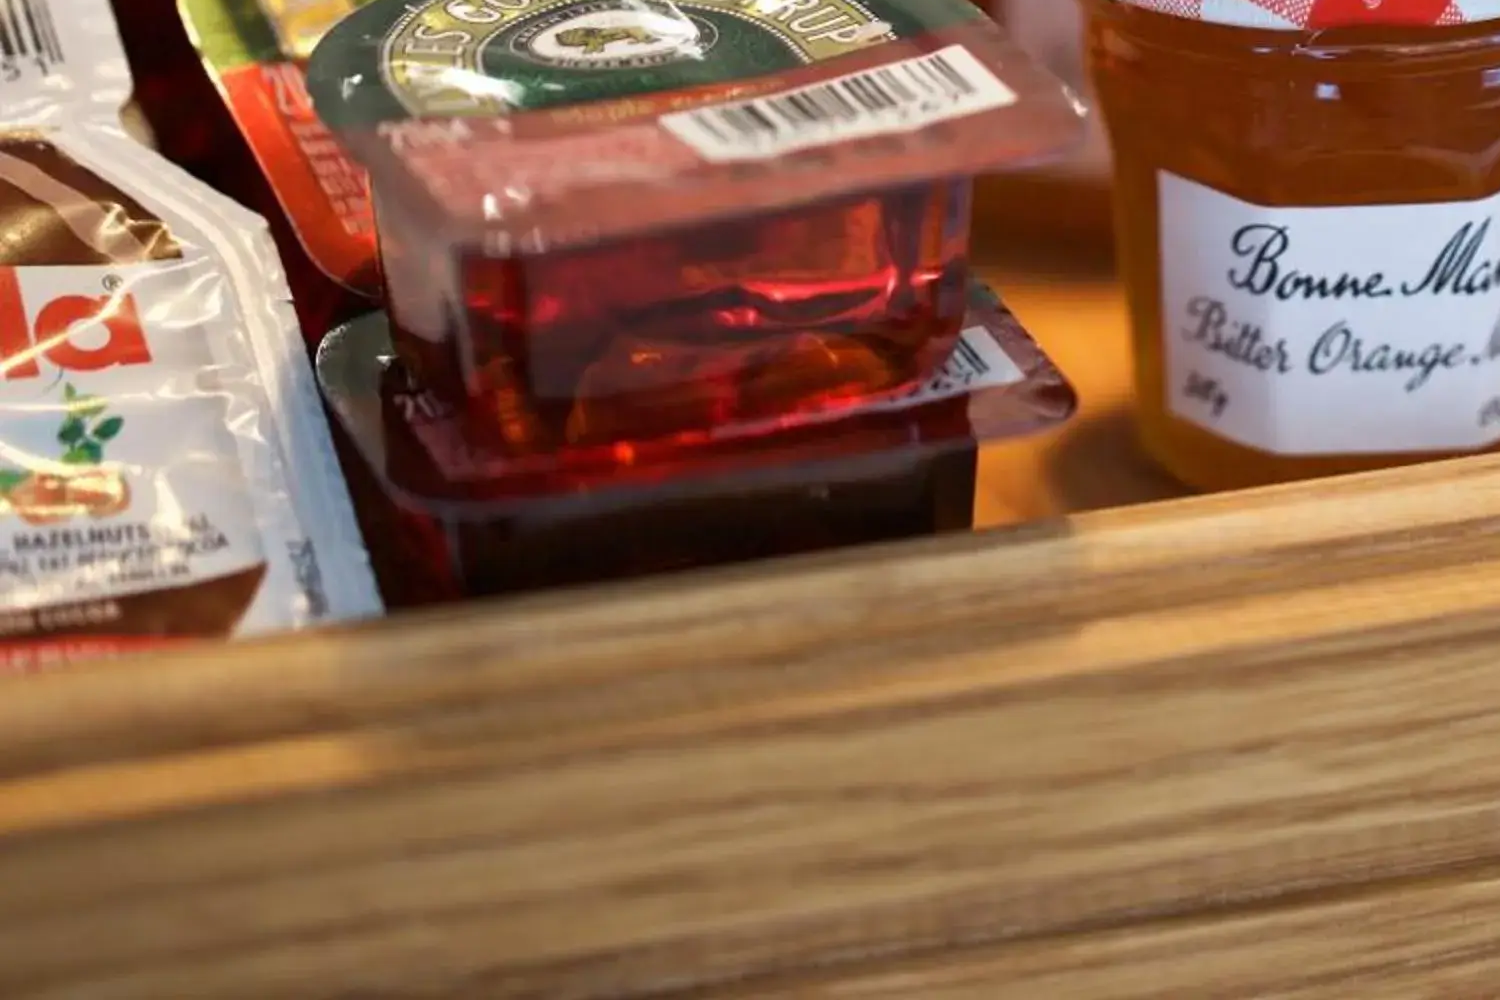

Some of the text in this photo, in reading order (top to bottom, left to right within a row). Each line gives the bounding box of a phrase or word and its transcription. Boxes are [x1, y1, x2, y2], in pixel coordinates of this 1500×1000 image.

[1228, 223, 1392, 300] Bonne
[1182, 296, 1292, 374] Bitter
[1307, 320, 1464, 391] Orange
[13, 523, 151, 552] HAZELNUTS
